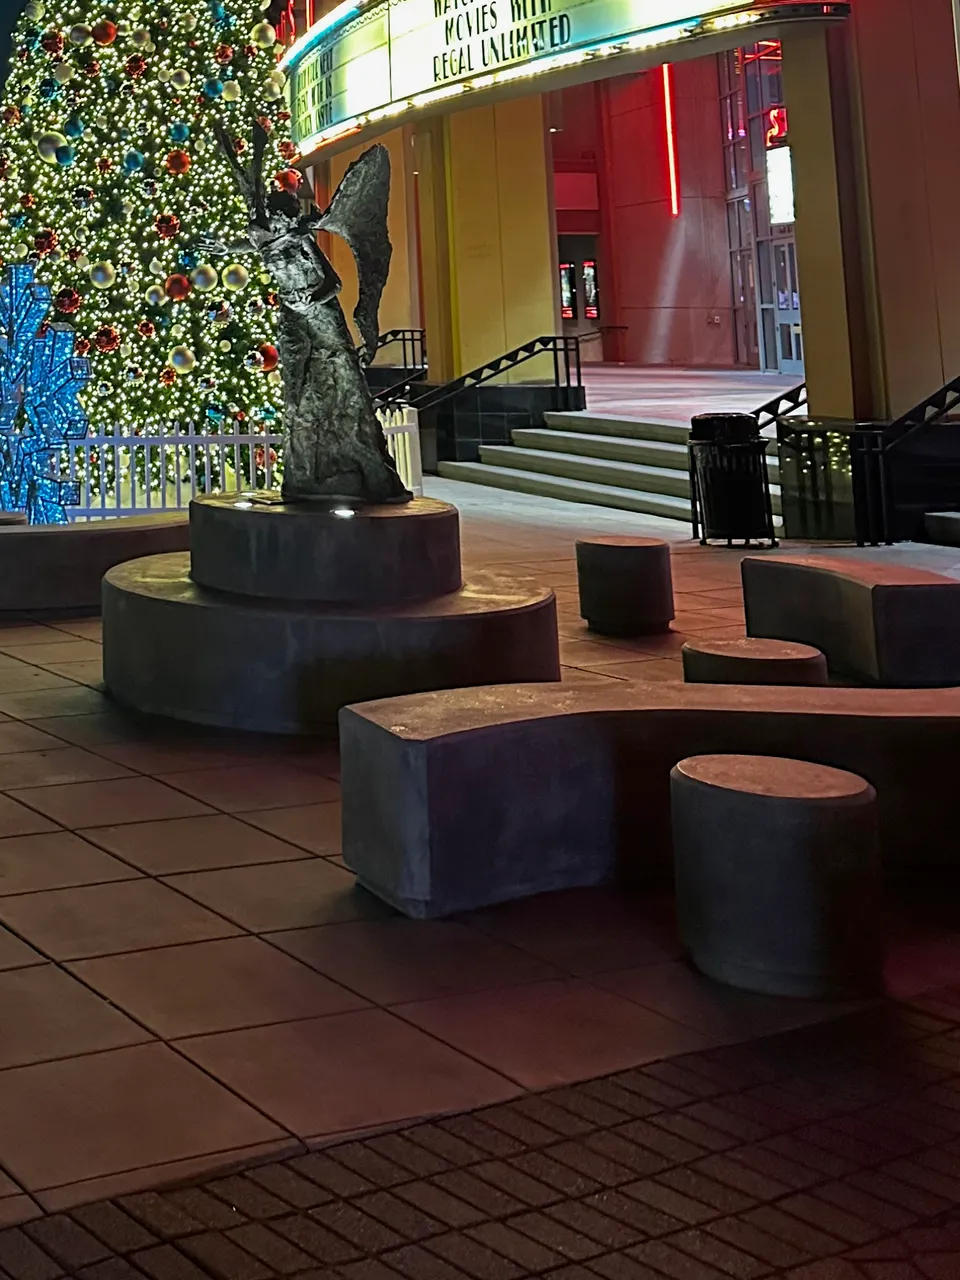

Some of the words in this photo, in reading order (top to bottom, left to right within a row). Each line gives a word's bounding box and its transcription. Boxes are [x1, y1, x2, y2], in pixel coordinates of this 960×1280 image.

[433, 44, 474, 82] REGAL
[481, 13, 571, 67] UNLIMITED
[444, 1, 498, 46] MOVIES
